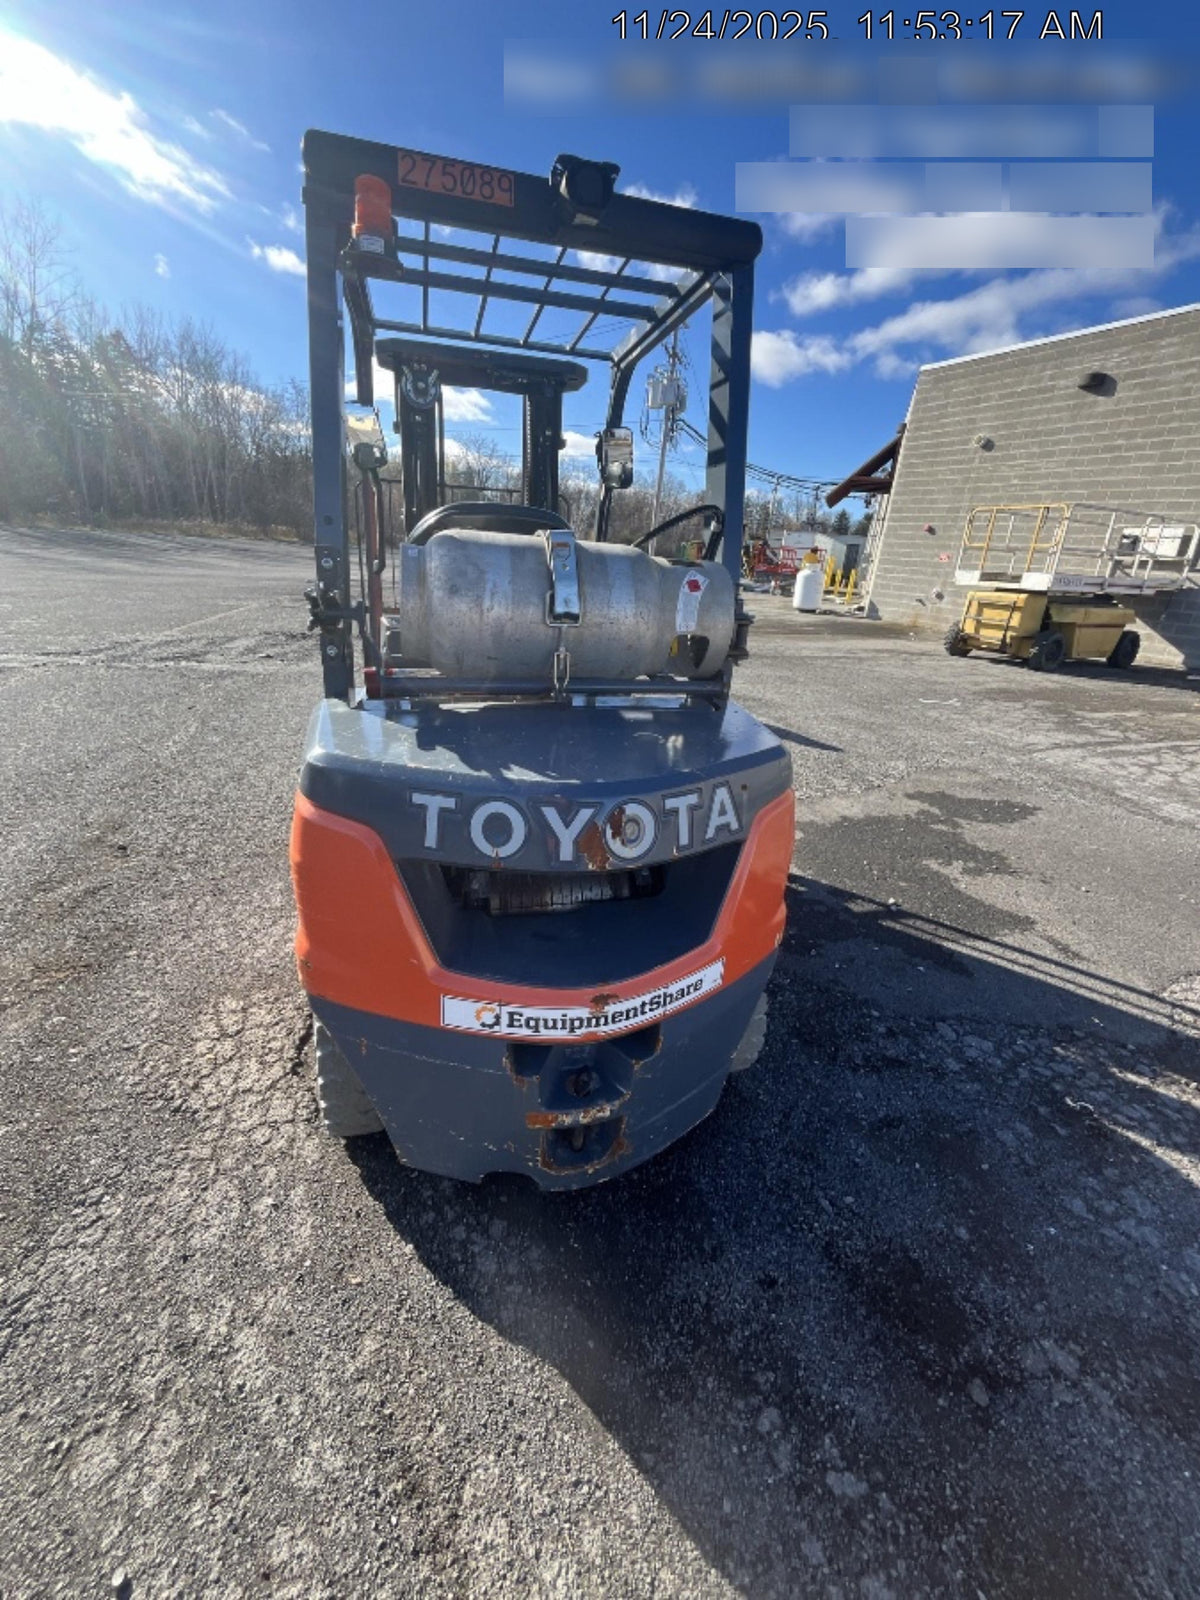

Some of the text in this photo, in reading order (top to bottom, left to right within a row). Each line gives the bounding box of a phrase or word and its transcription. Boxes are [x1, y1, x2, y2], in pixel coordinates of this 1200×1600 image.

[401, 154, 513, 205] 275089
[411, 786, 740, 861] TOYOTA
[506, 978, 704, 1033] EquipmentShare
